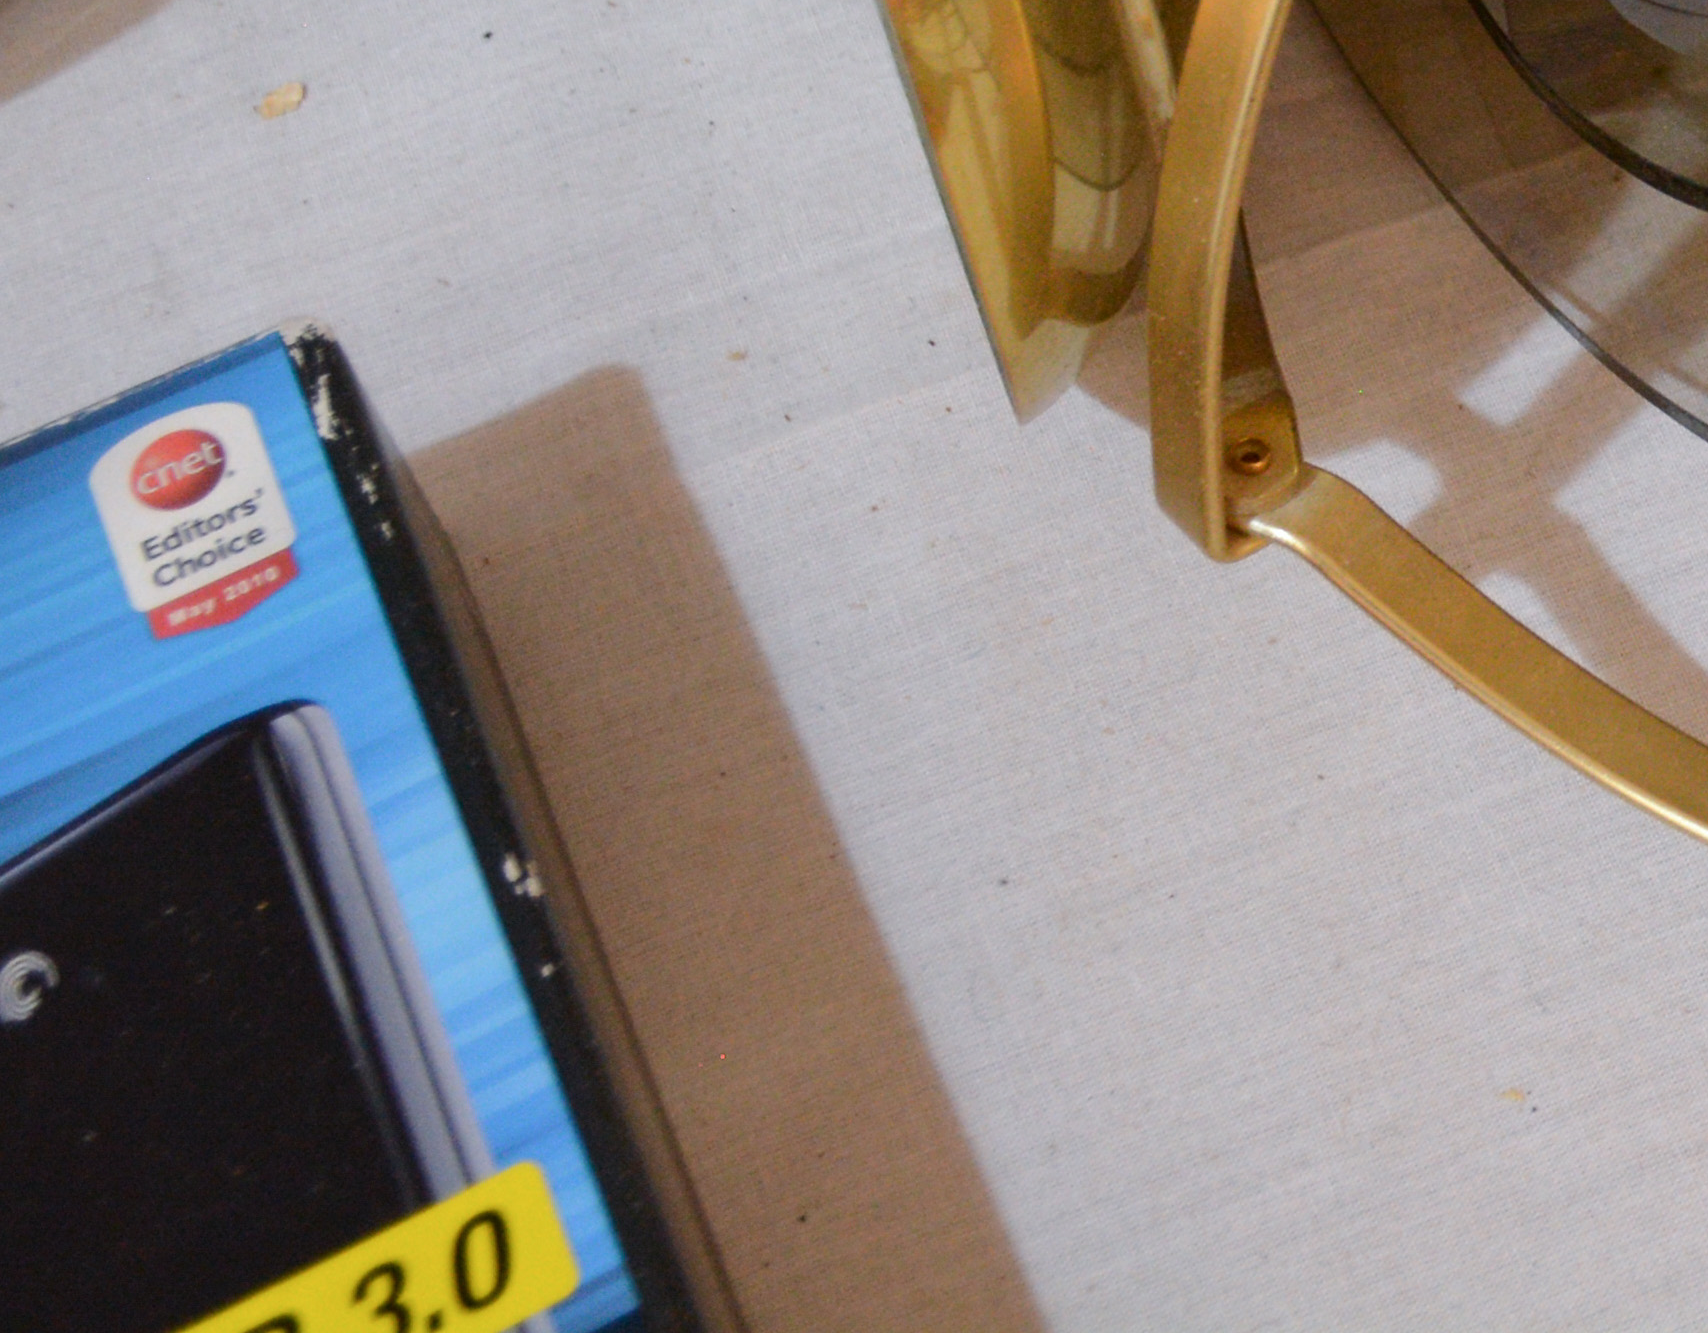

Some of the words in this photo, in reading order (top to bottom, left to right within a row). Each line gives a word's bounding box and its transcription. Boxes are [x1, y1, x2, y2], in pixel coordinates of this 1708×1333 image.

[136, 440, 222, 495] cnet
[140, 487, 264, 562] Editors'
[152, 524, 267, 588] Choice
[166, 596, 218, 626] May
[223, 564, 281, 602] 2010
[352, 1209, 512, 1333] 3.0
